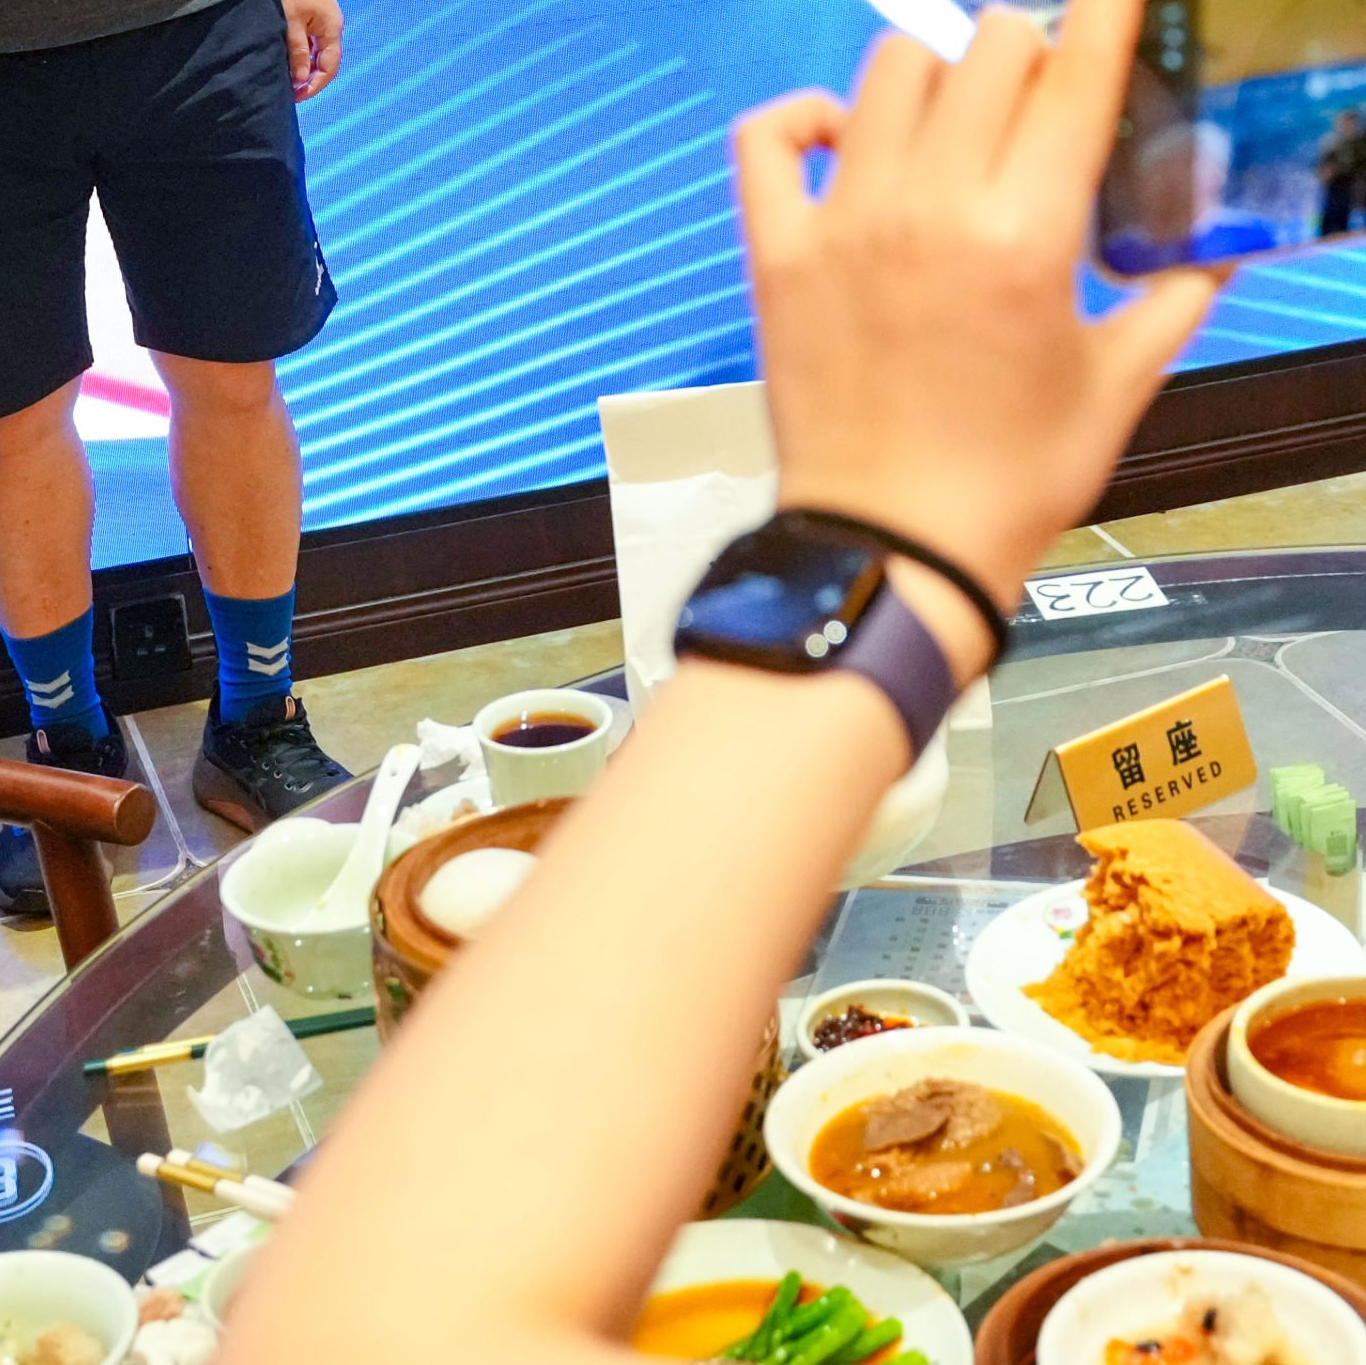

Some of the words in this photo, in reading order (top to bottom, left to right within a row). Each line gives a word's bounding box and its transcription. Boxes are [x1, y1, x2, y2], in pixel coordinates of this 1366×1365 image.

[1036, 575, 1154, 612] 223
[1111, 720, 1202, 791] 留座
[1112, 760, 1223, 823] RESERVED
